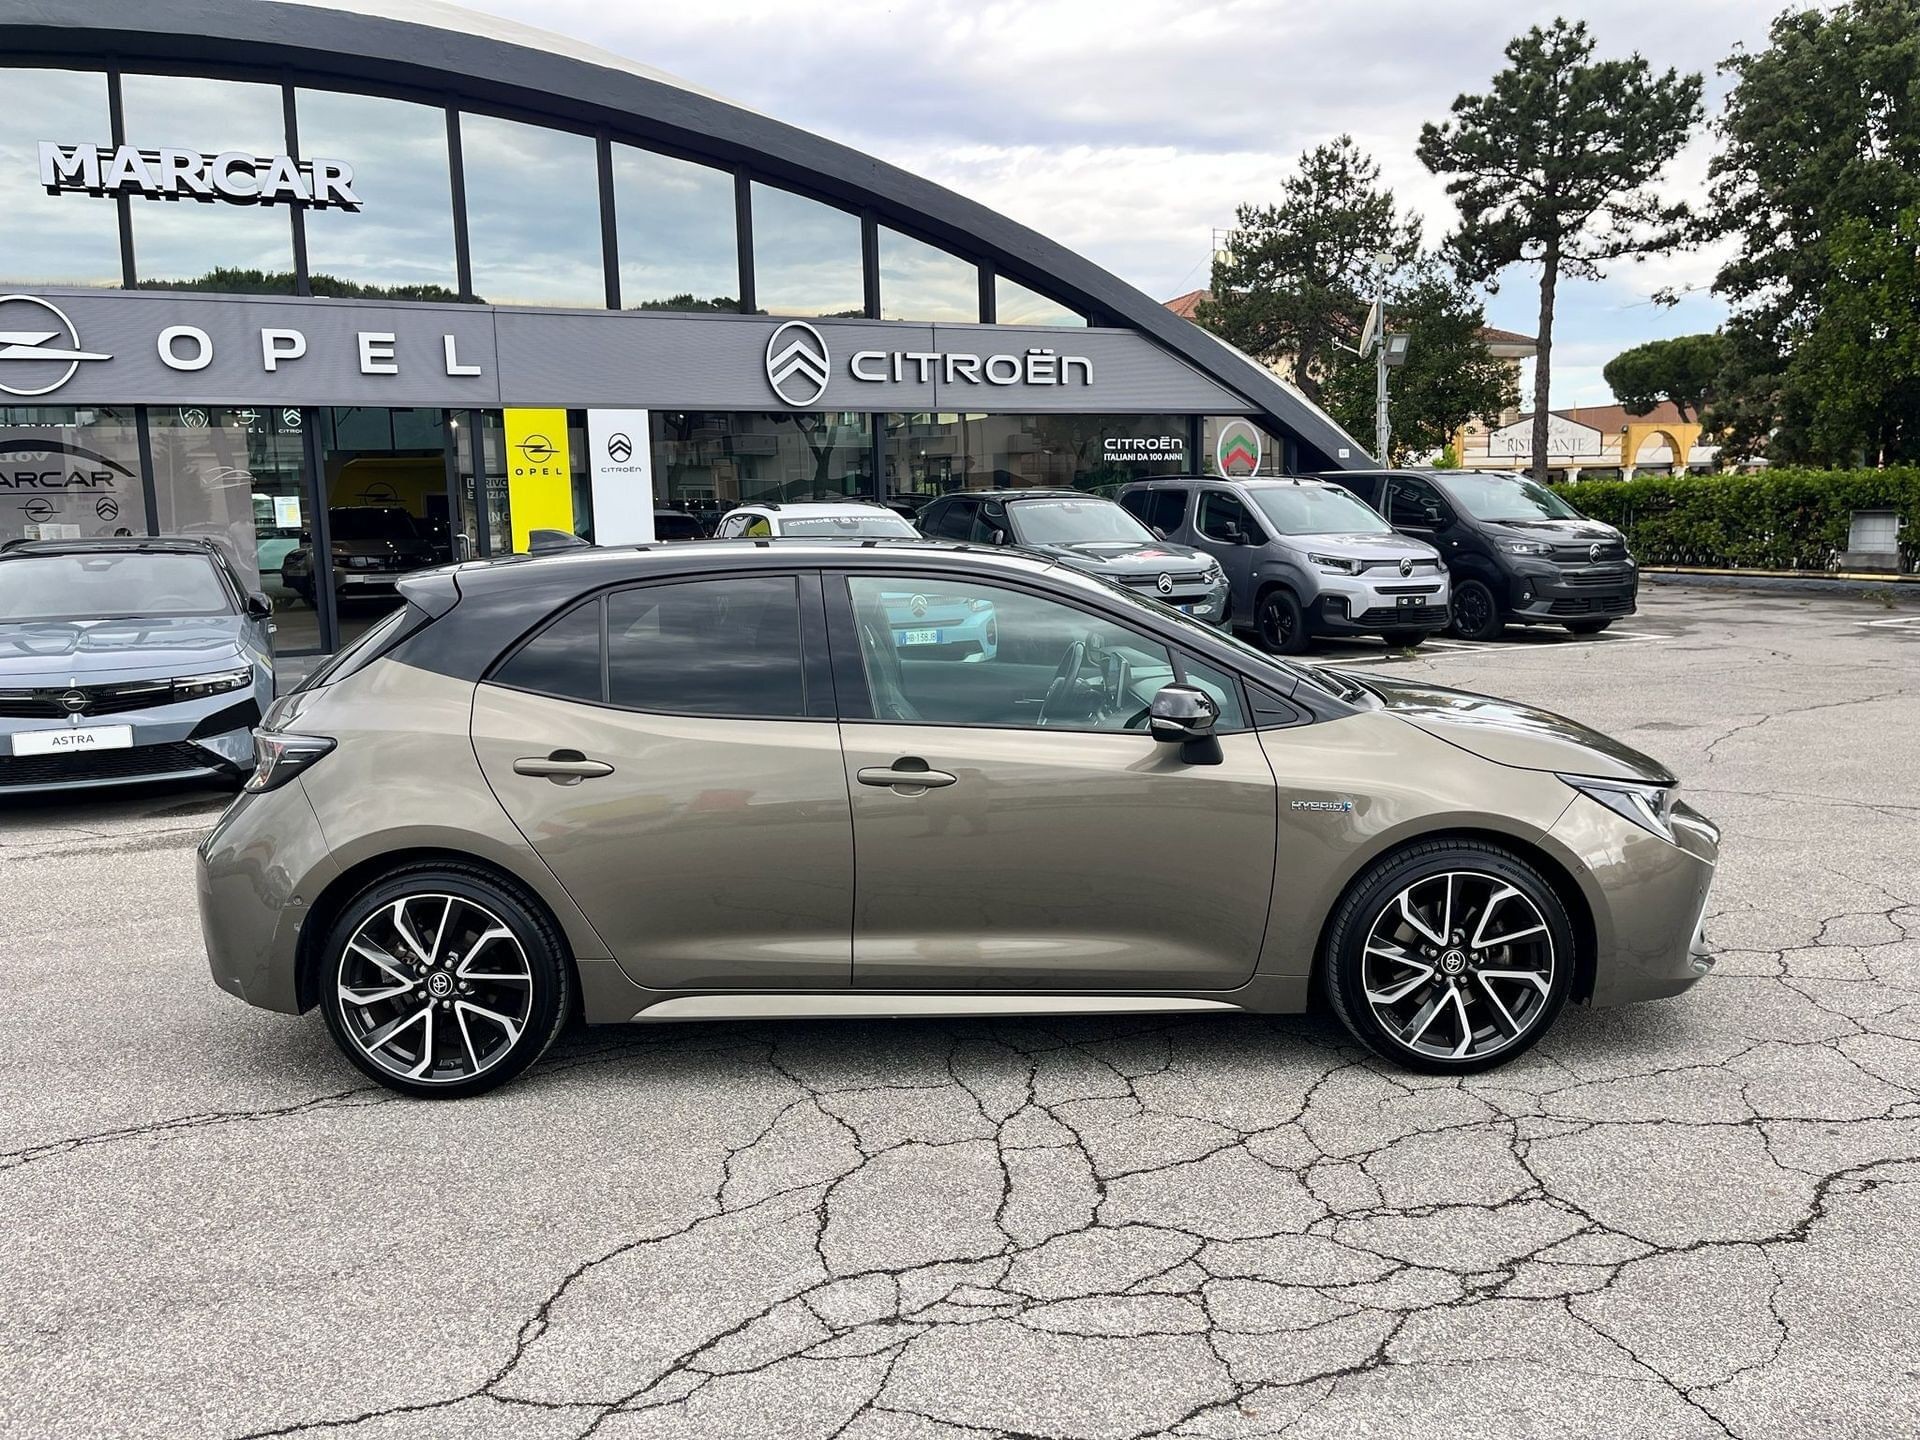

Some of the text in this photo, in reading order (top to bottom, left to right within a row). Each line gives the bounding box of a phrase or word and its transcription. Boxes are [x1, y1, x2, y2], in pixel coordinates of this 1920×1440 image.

[37, 140, 363, 206] MARCAR
[157, 325, 482, 376] OPEL
[1507, 438, 1585, 453] RISTANTE
[1104, 453, 1183, 461] ITALIANI DA 100 ANNI
[515, 468, 562, 476] OPEL
[52, 734, 95, 746] ASTRA
